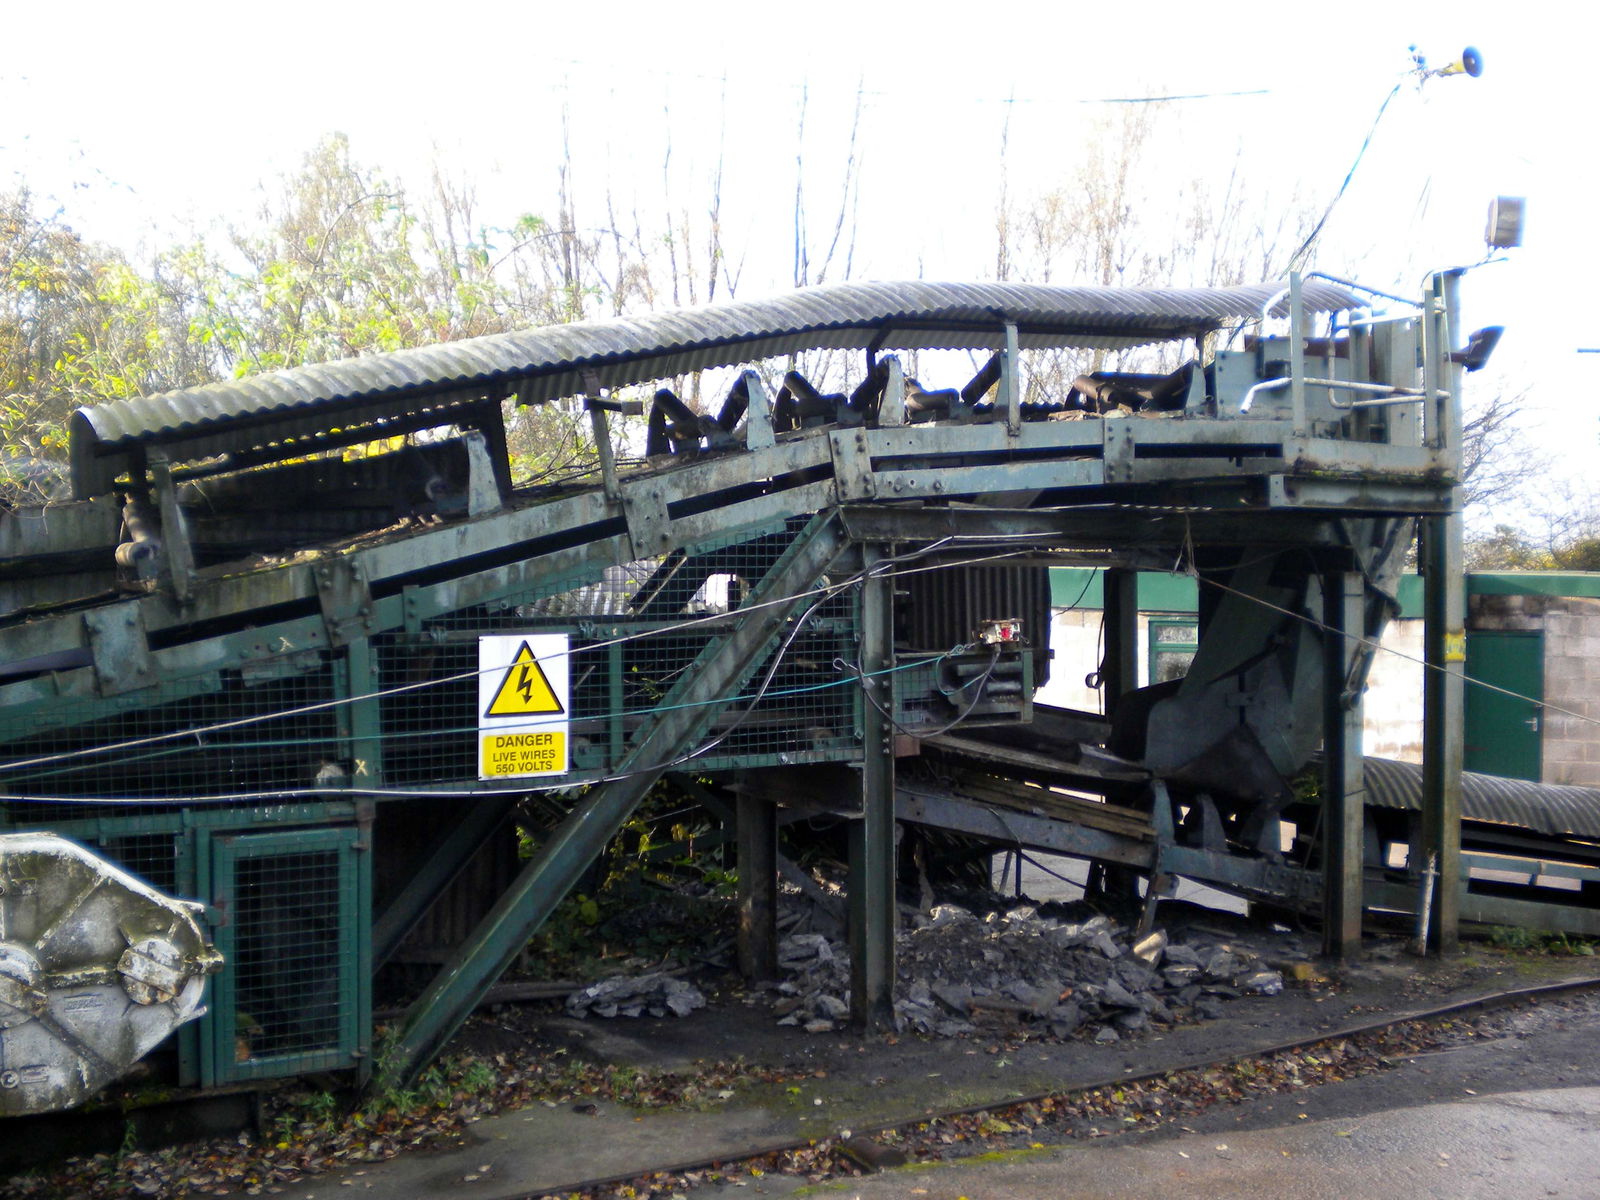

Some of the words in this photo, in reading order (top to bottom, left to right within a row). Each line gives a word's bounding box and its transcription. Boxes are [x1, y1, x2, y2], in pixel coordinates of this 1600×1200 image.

[496, 734, 552, 748] DANGER
[493, 752, 517, 762] LIVE
[520, 749, 556, 760] WIRES
[496, 763, 514, 773] 550
[518, 761, 552, 771] VOLTS
